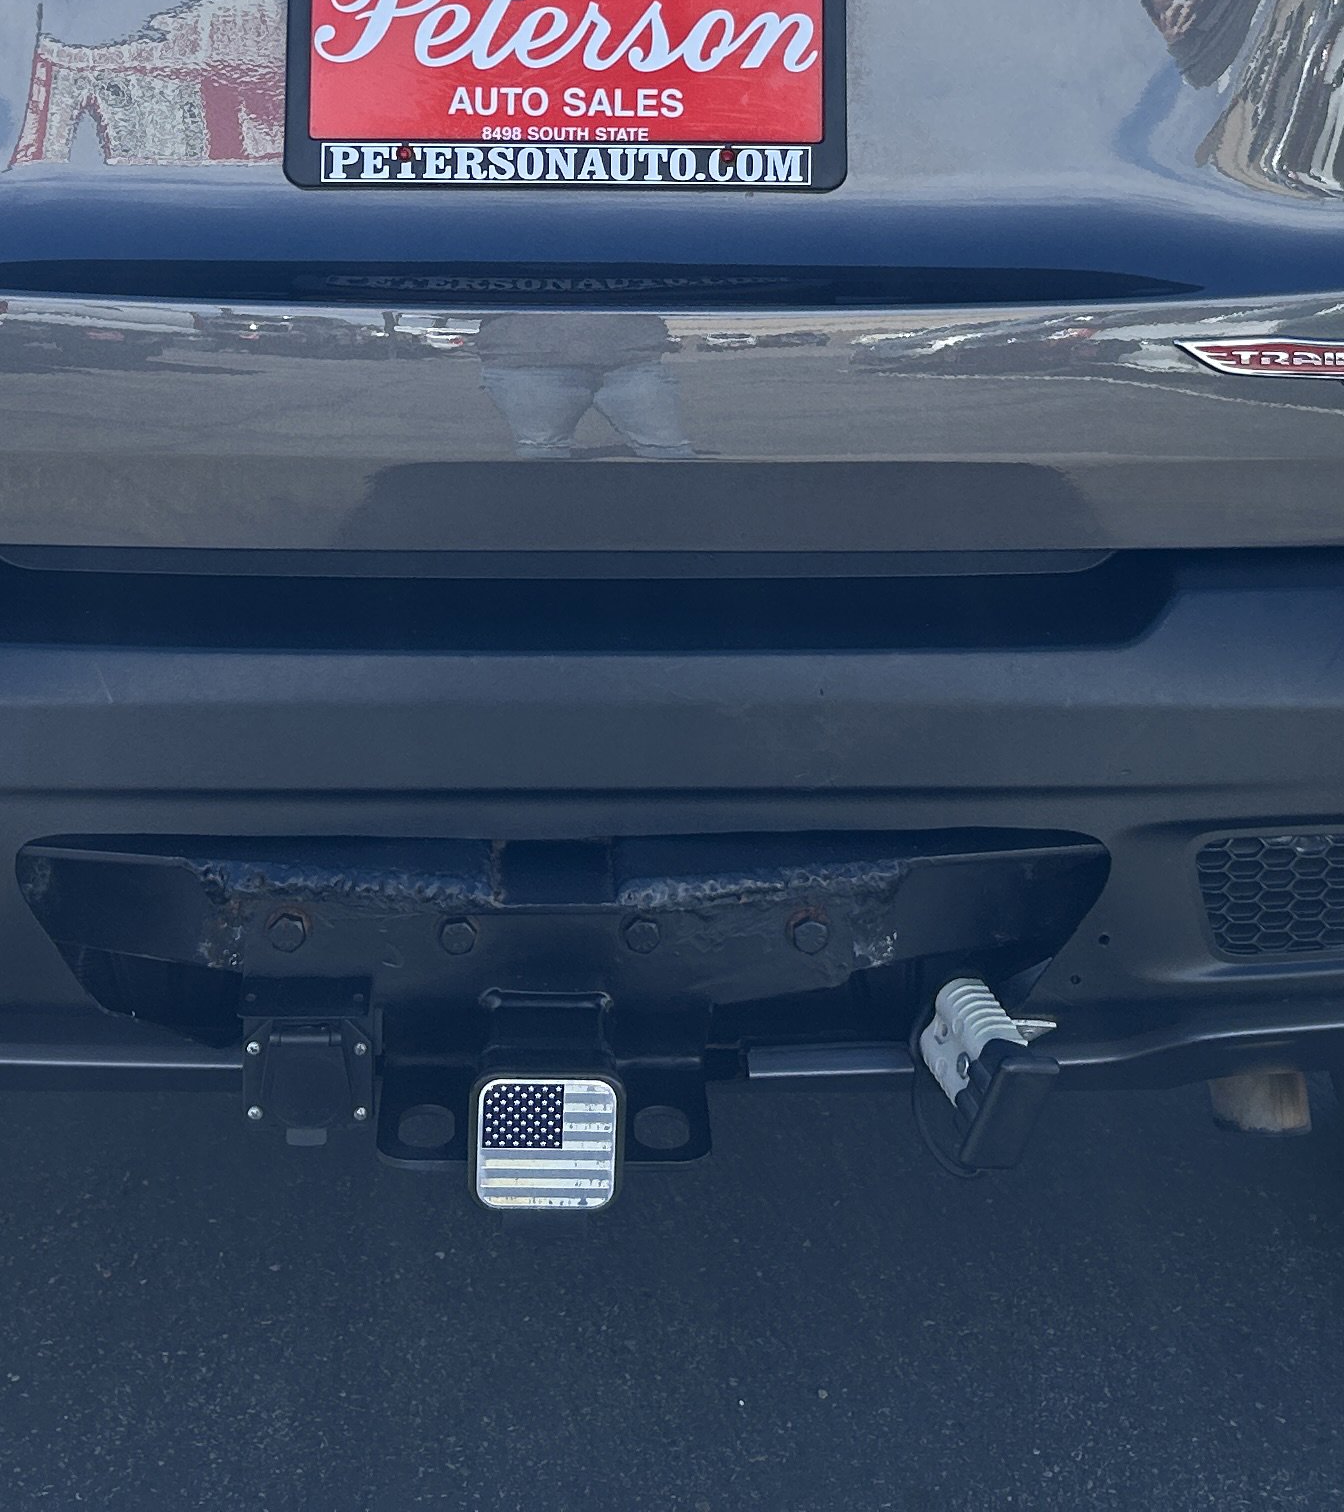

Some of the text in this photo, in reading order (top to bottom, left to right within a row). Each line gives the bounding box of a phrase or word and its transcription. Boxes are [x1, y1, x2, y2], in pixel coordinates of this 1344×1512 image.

[448, 87, 685, 118] AUTO SALES
[481, 126, 649, 142] 8498 SOUTH STATE
[329, 146, 804, 183] PETERSONAUTO.COM
